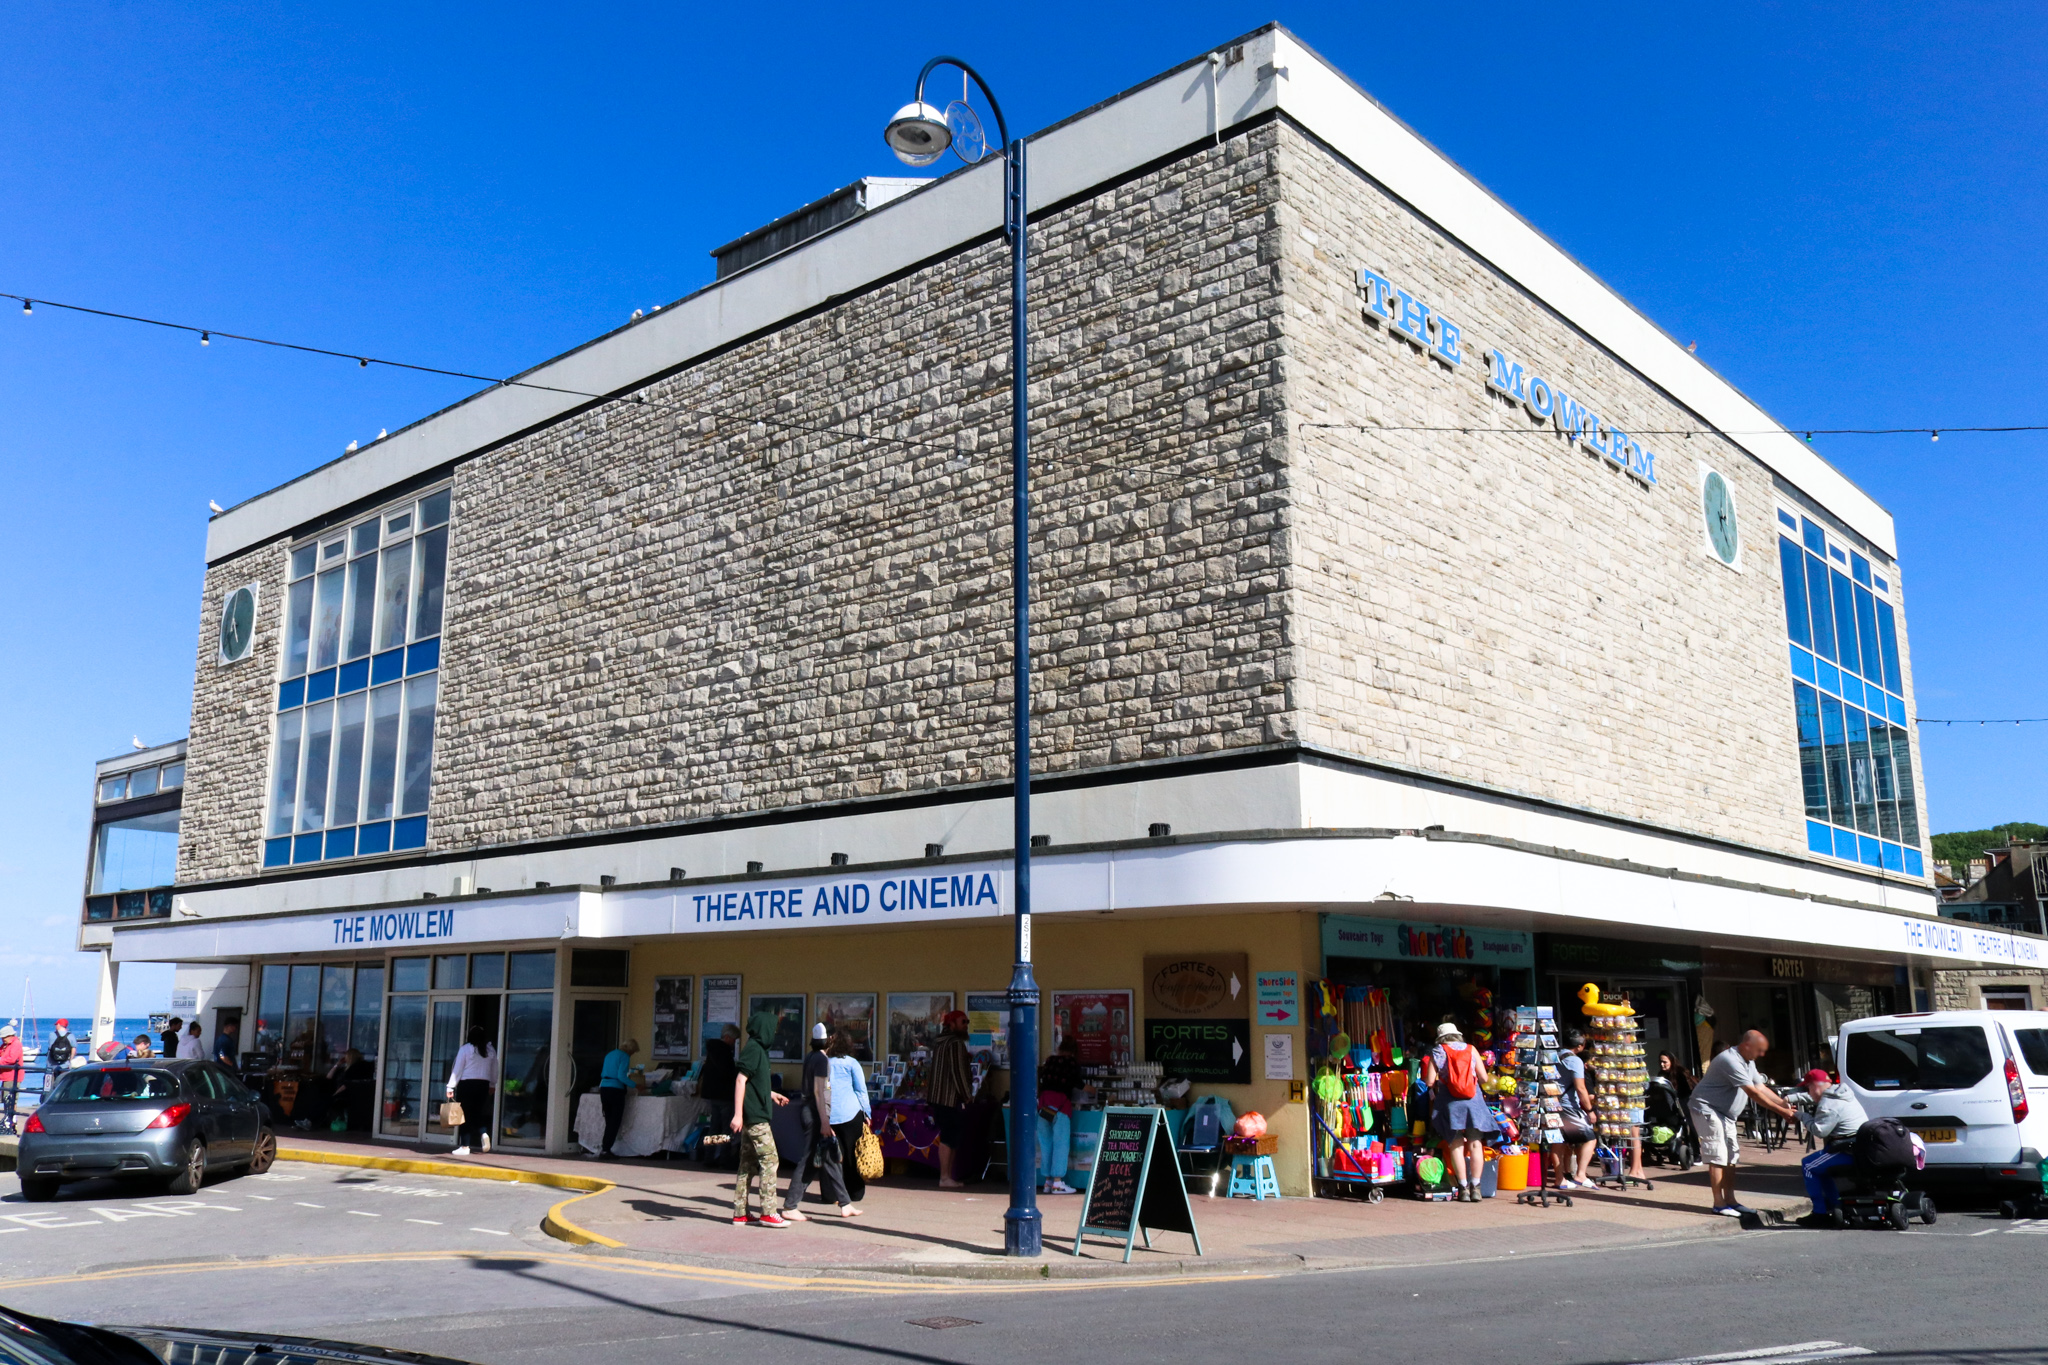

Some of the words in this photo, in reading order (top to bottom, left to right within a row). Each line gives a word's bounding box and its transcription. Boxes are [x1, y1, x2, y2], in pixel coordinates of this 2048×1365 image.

[1356, 267, 1462, 367] THE
[1484, 347, 1658, 487] MOWLEM
[692, 888, 803, 923] THEATRE
[812, 882, 870, 917] AND
[879, 873, 998, 913] CINEMA
[333, 916, 366, 944] THE
[369, 909, 454, 942] MOWLEM
[1338, 929, 1368, 943] Souvenirs
[1370, 931, 1384, 946] Toys
[1398, 923, 1474, 960] ShoreSide
[1903, 921, 1924, 947] THE
[1924, 924, 1965, 953] MOWLEM
[1973, 934, 2003, 956] THEATRE
[2016, 941, 2039, 961] CINEMA
[1161, 961, 1216, 979] FORTES
[1771, 958, 1805, 978] FORTES
[1258, 977, 1295, 987] ShoreSide
[1160, 1001, 1202, 1014] ESTABLISHED
[1152, 1025, 1229, 1040] FORTES
[1154, 1041, 1207, 1062] Gelateria
[1168, 1066, 1193, 1074] CREAM
[1194, 1067, 1230, 1075] PARLOUR
[1290, 1082, 1303, 1101] H
[1118, 1119, 1140, 1130] FUDGE
[1108, 1129, 1142, 1140] SHORTBREAD
[1929, 1130, 1952, 1141] HJJ
[1107, 1141, 1118, 1151] TEA
[1118, 1141, 1140, 1151] TOWELS
[1101, 1150, 1120, 1162] FRIDGE
[1120, 1151, 1144, 1163] MAGNETS
[1108, 1163, 1133, 1176] ROCK
